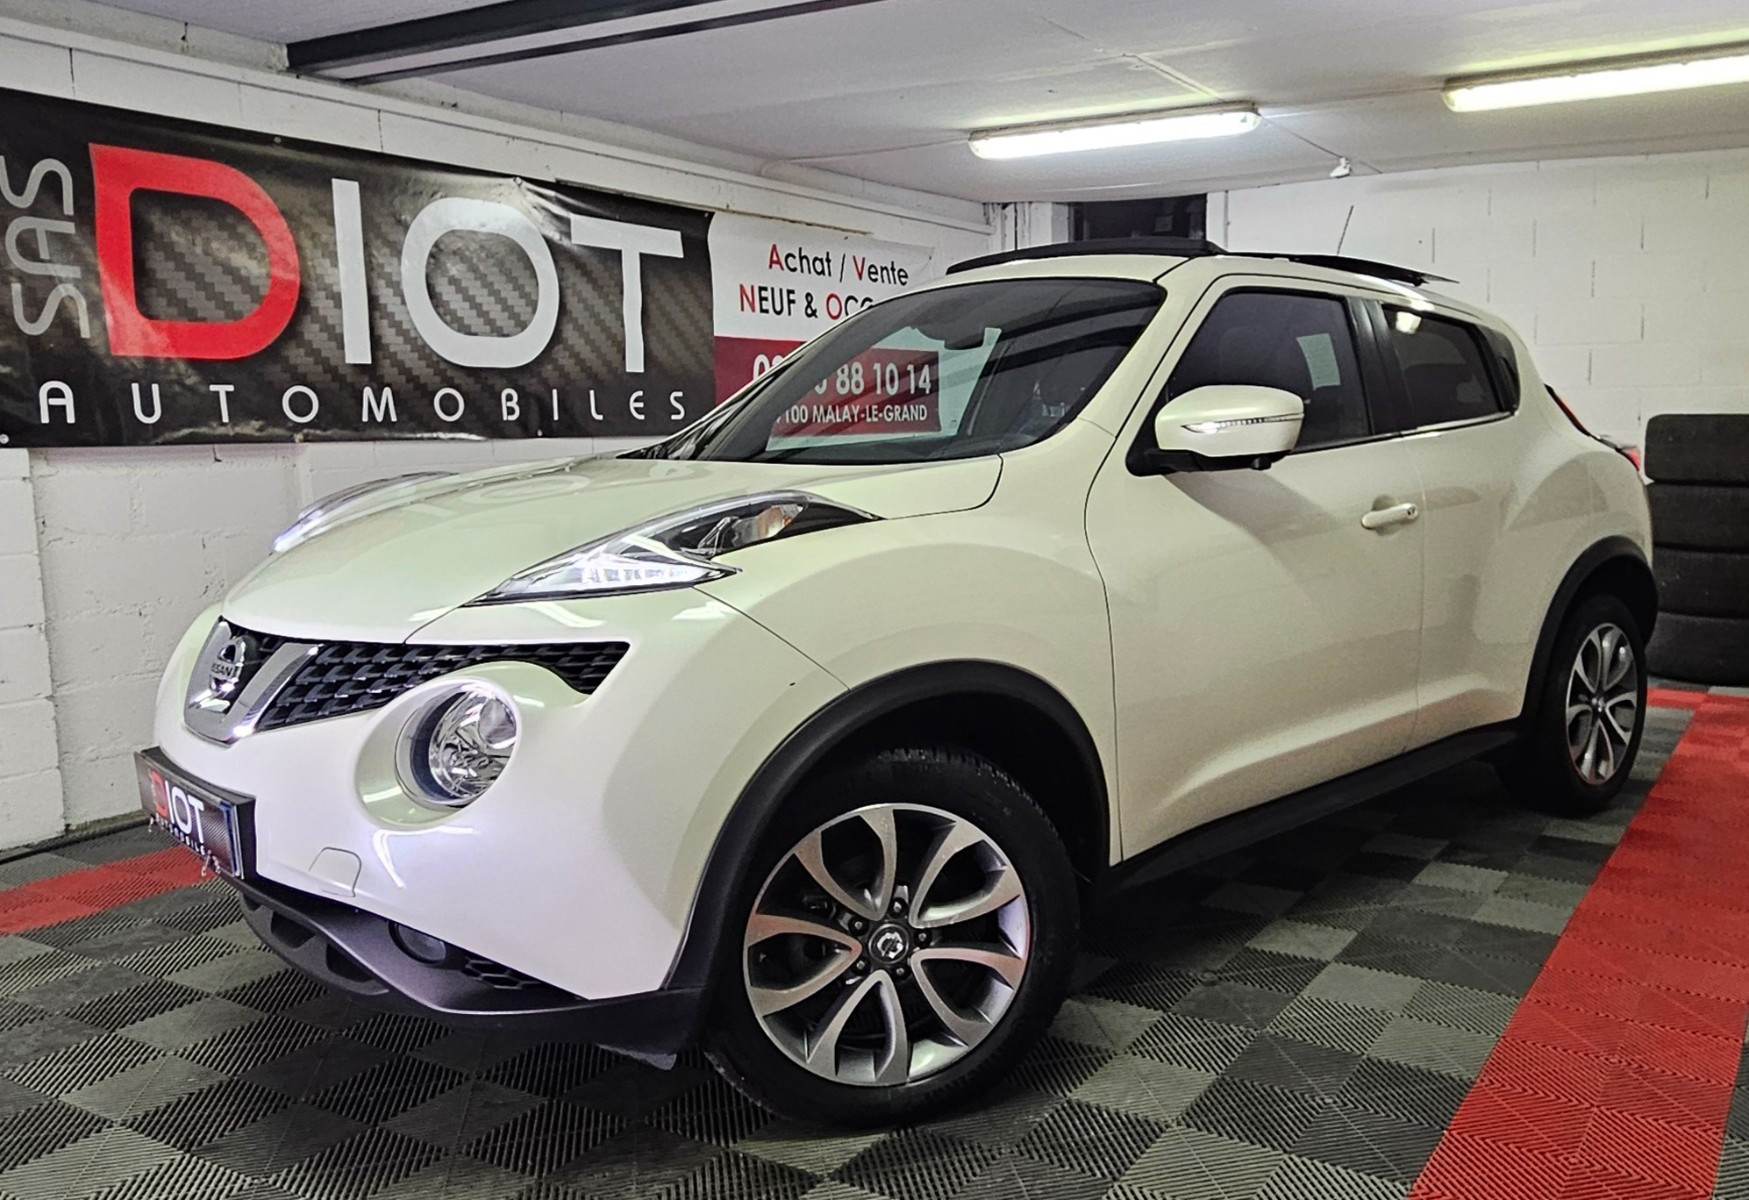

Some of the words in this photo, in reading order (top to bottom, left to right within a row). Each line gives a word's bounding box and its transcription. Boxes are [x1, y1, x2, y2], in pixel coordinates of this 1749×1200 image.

[0, 155, 91, 339] SAS
[89, 142, 684, 373] DIOT
[768, 243, 833, 278] Achat
[852, 255, 909, 286] Vente
[739, 283, 797, 317] NEUF
[804, 291, 818, 318] &
[872, 361, 899, 396] 10
[906, 363, 932, 395] 14
[38, 379, 686, 425] AUTOMOBILES
[811, 404, 928, 424] MALAY-LE-GRAND
